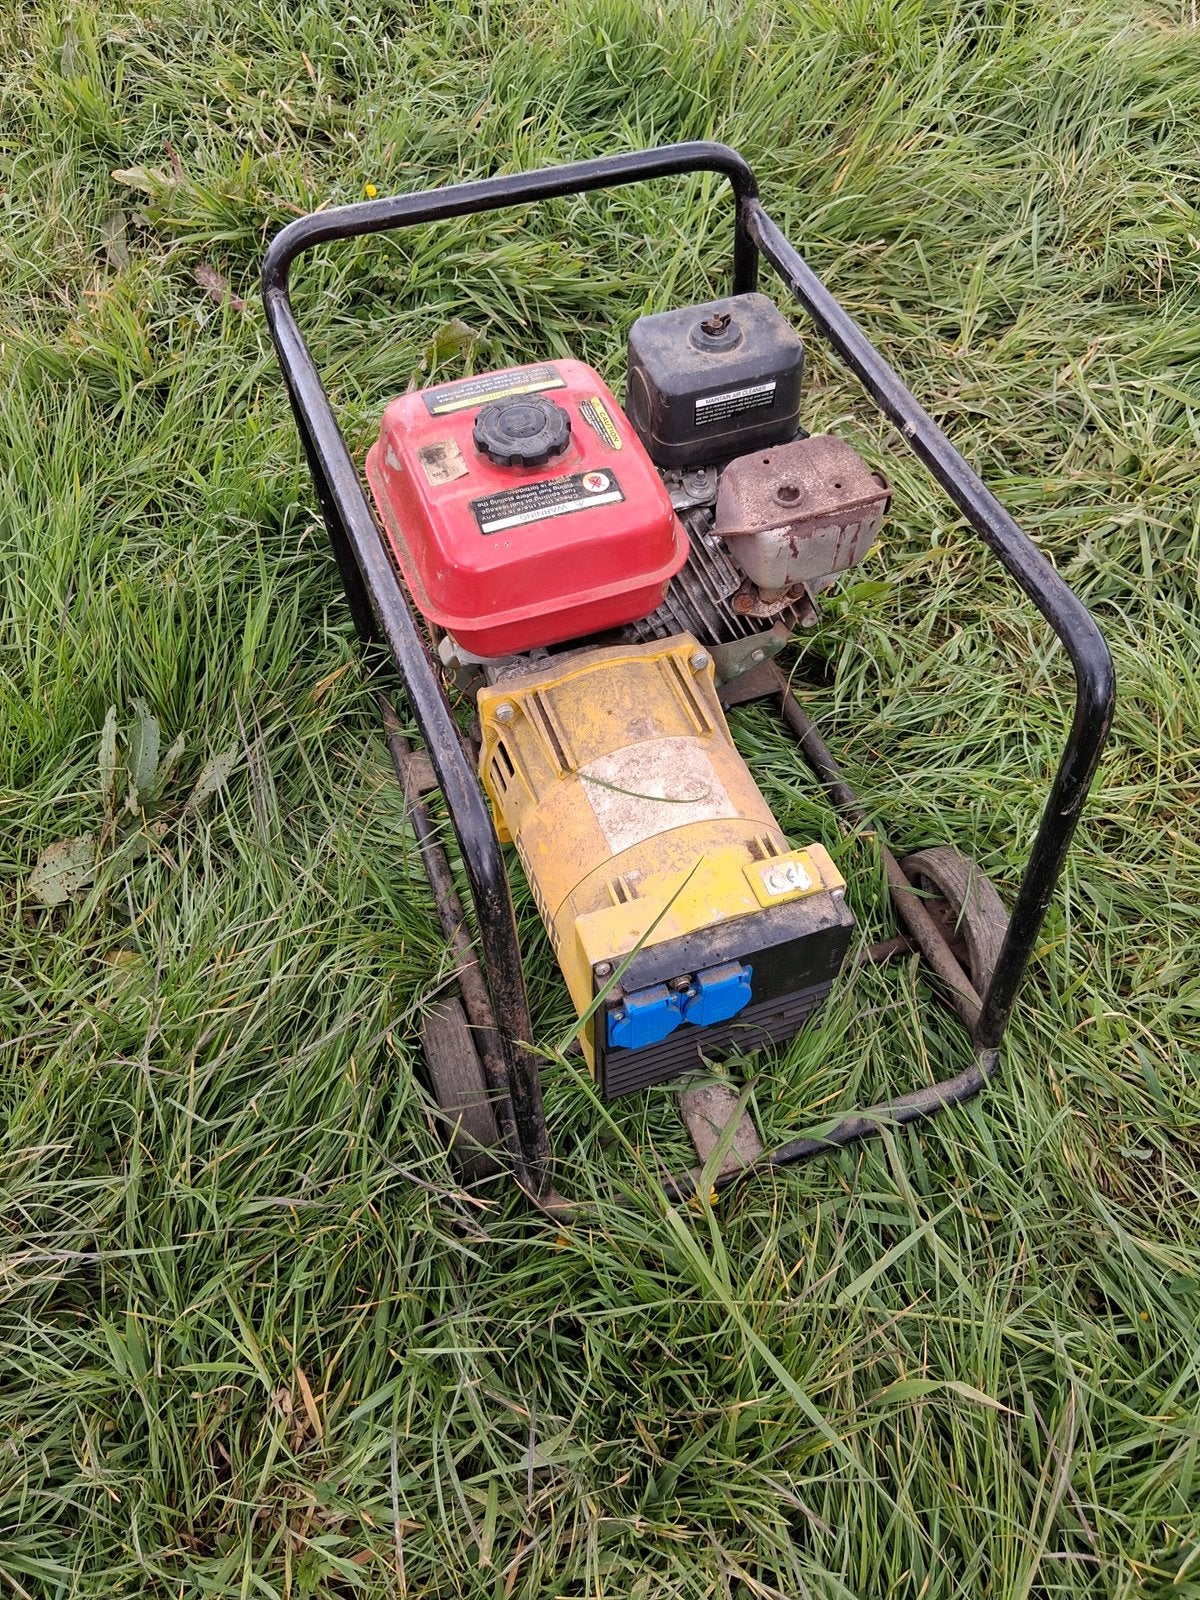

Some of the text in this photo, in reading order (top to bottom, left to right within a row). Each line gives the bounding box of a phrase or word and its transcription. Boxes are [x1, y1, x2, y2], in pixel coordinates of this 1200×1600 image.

[705, 395, 730, 404] MAINTAIN
[742, 386, 766, 394] CLEANER
[599, 412, 620, 442] CAUTION
[538, 487, 552, 495] fuel
[554, 492, 579, 503] Check
[509, 500, 524, 508] fuel
[480, 512, 496, 520] any
[519, 505, 567, 520] WARNING
